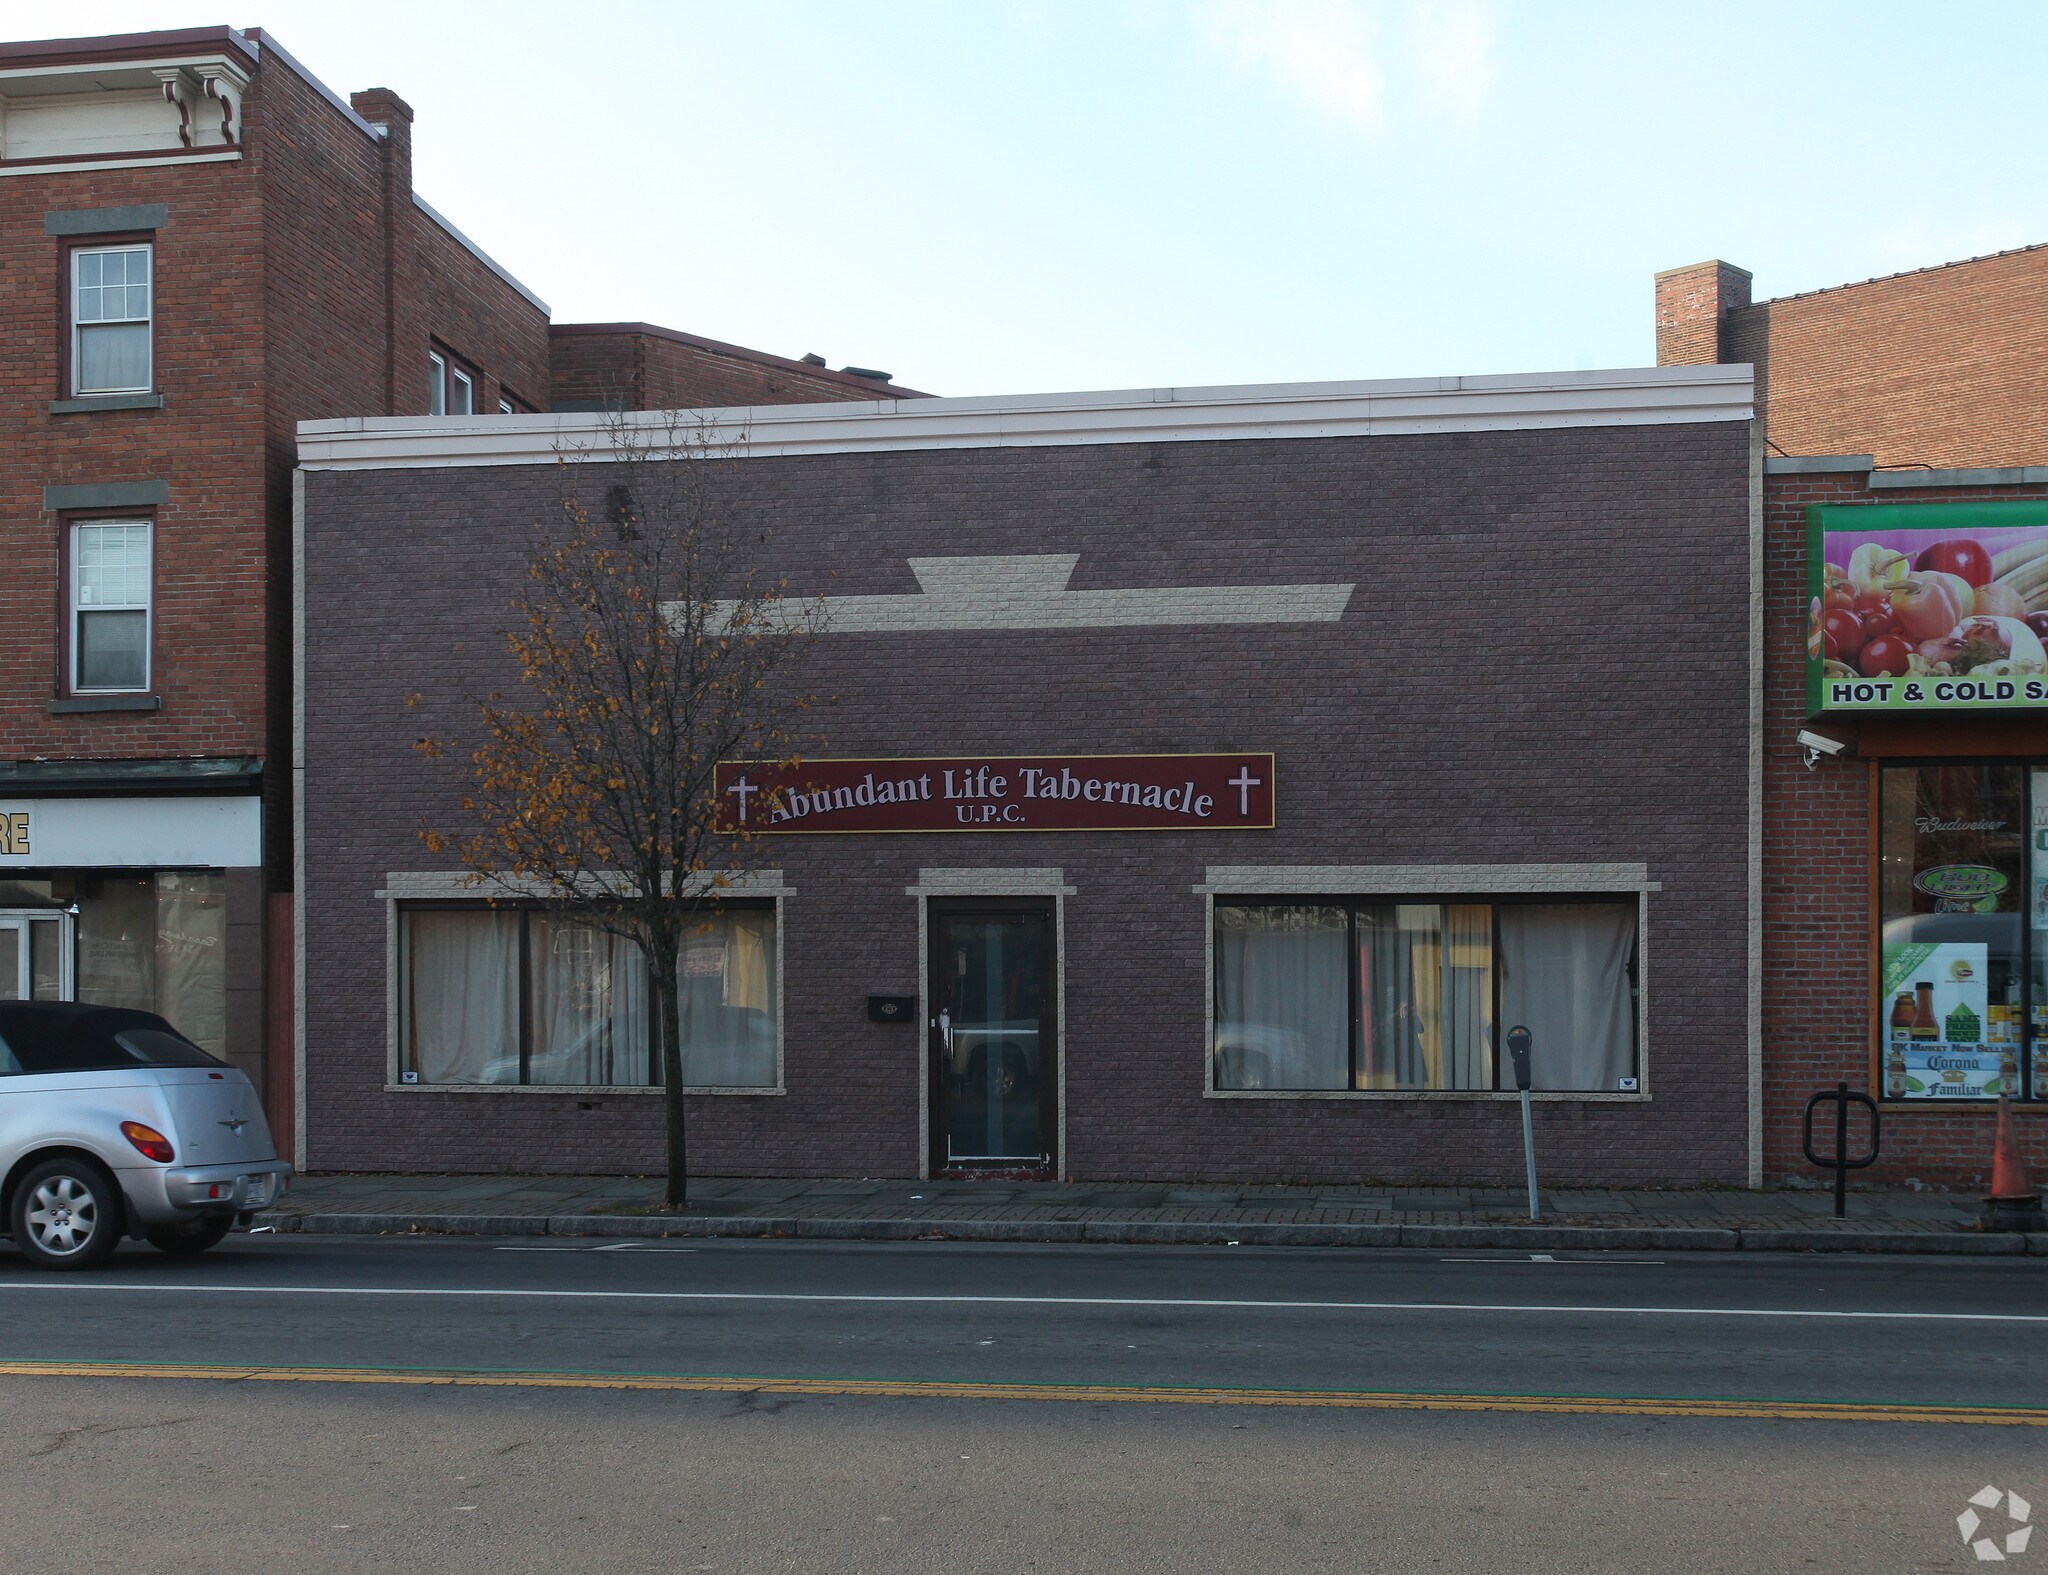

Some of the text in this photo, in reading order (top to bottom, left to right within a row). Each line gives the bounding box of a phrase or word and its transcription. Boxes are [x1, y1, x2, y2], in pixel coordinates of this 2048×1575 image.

[1832, 681, 2048, 702] HOT & COLD S
[770, 764, 1214, 825] Abundant Life Tabernacle
[956, 804, 1026, 824] U.P.C.
[1914, 816, 2007, 834] Budweiser
[1940, 872, 1990, 882] BUD
[1927, 1055, 1980, 1073] Corona
[1926, 1082, 1983, 1097] Familiar
